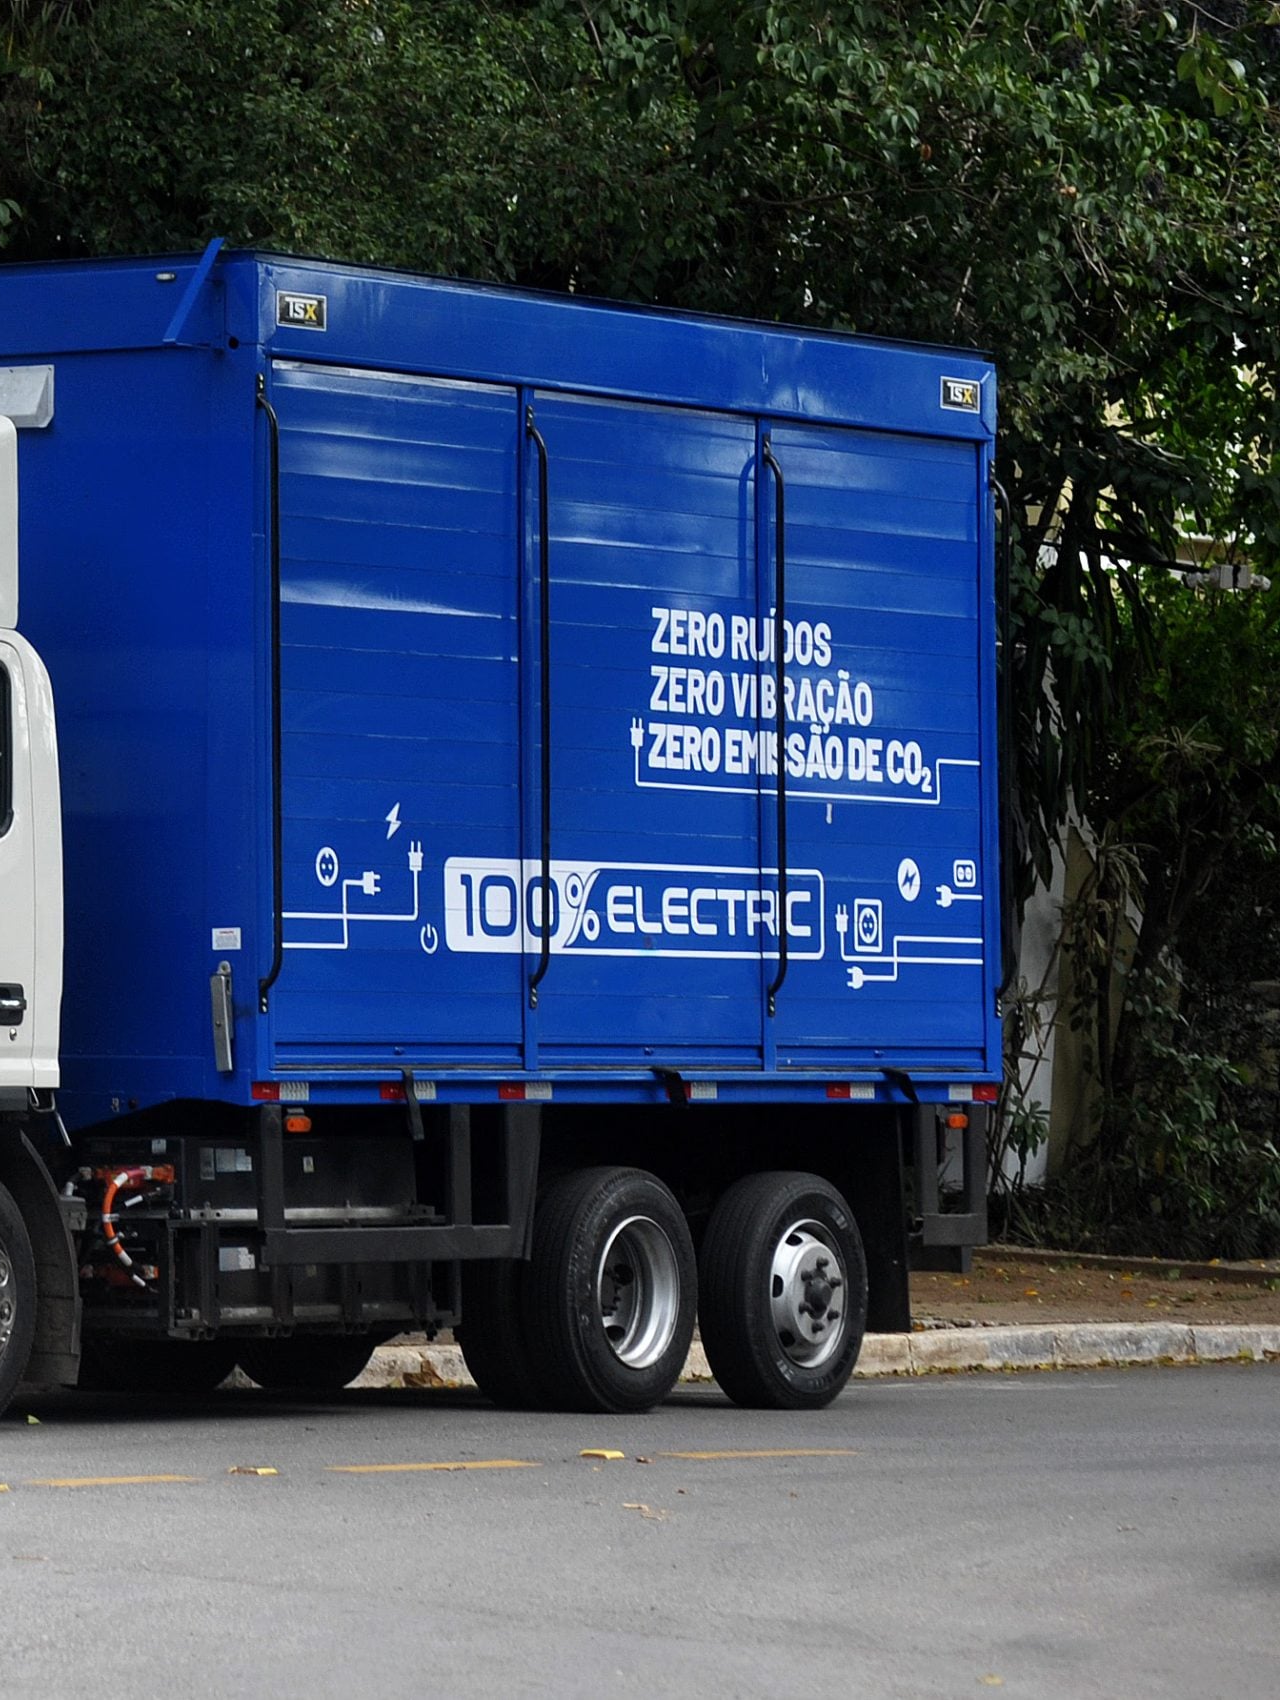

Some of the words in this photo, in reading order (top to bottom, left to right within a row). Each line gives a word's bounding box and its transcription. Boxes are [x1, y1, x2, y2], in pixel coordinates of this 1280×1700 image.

[284, 296, 318, 320] TSX
[947, 382, 973, 404] TSX
[651, 607, 725, 659] ZERO
[649, 665, 725, 716] ZERO
[731, 669, 873, 734] VIBRAÇÃO
[648, 722, 721, 773] ZERO
[848, 737, 883, 782] DE
[460, 870, 601, 948] 100%
